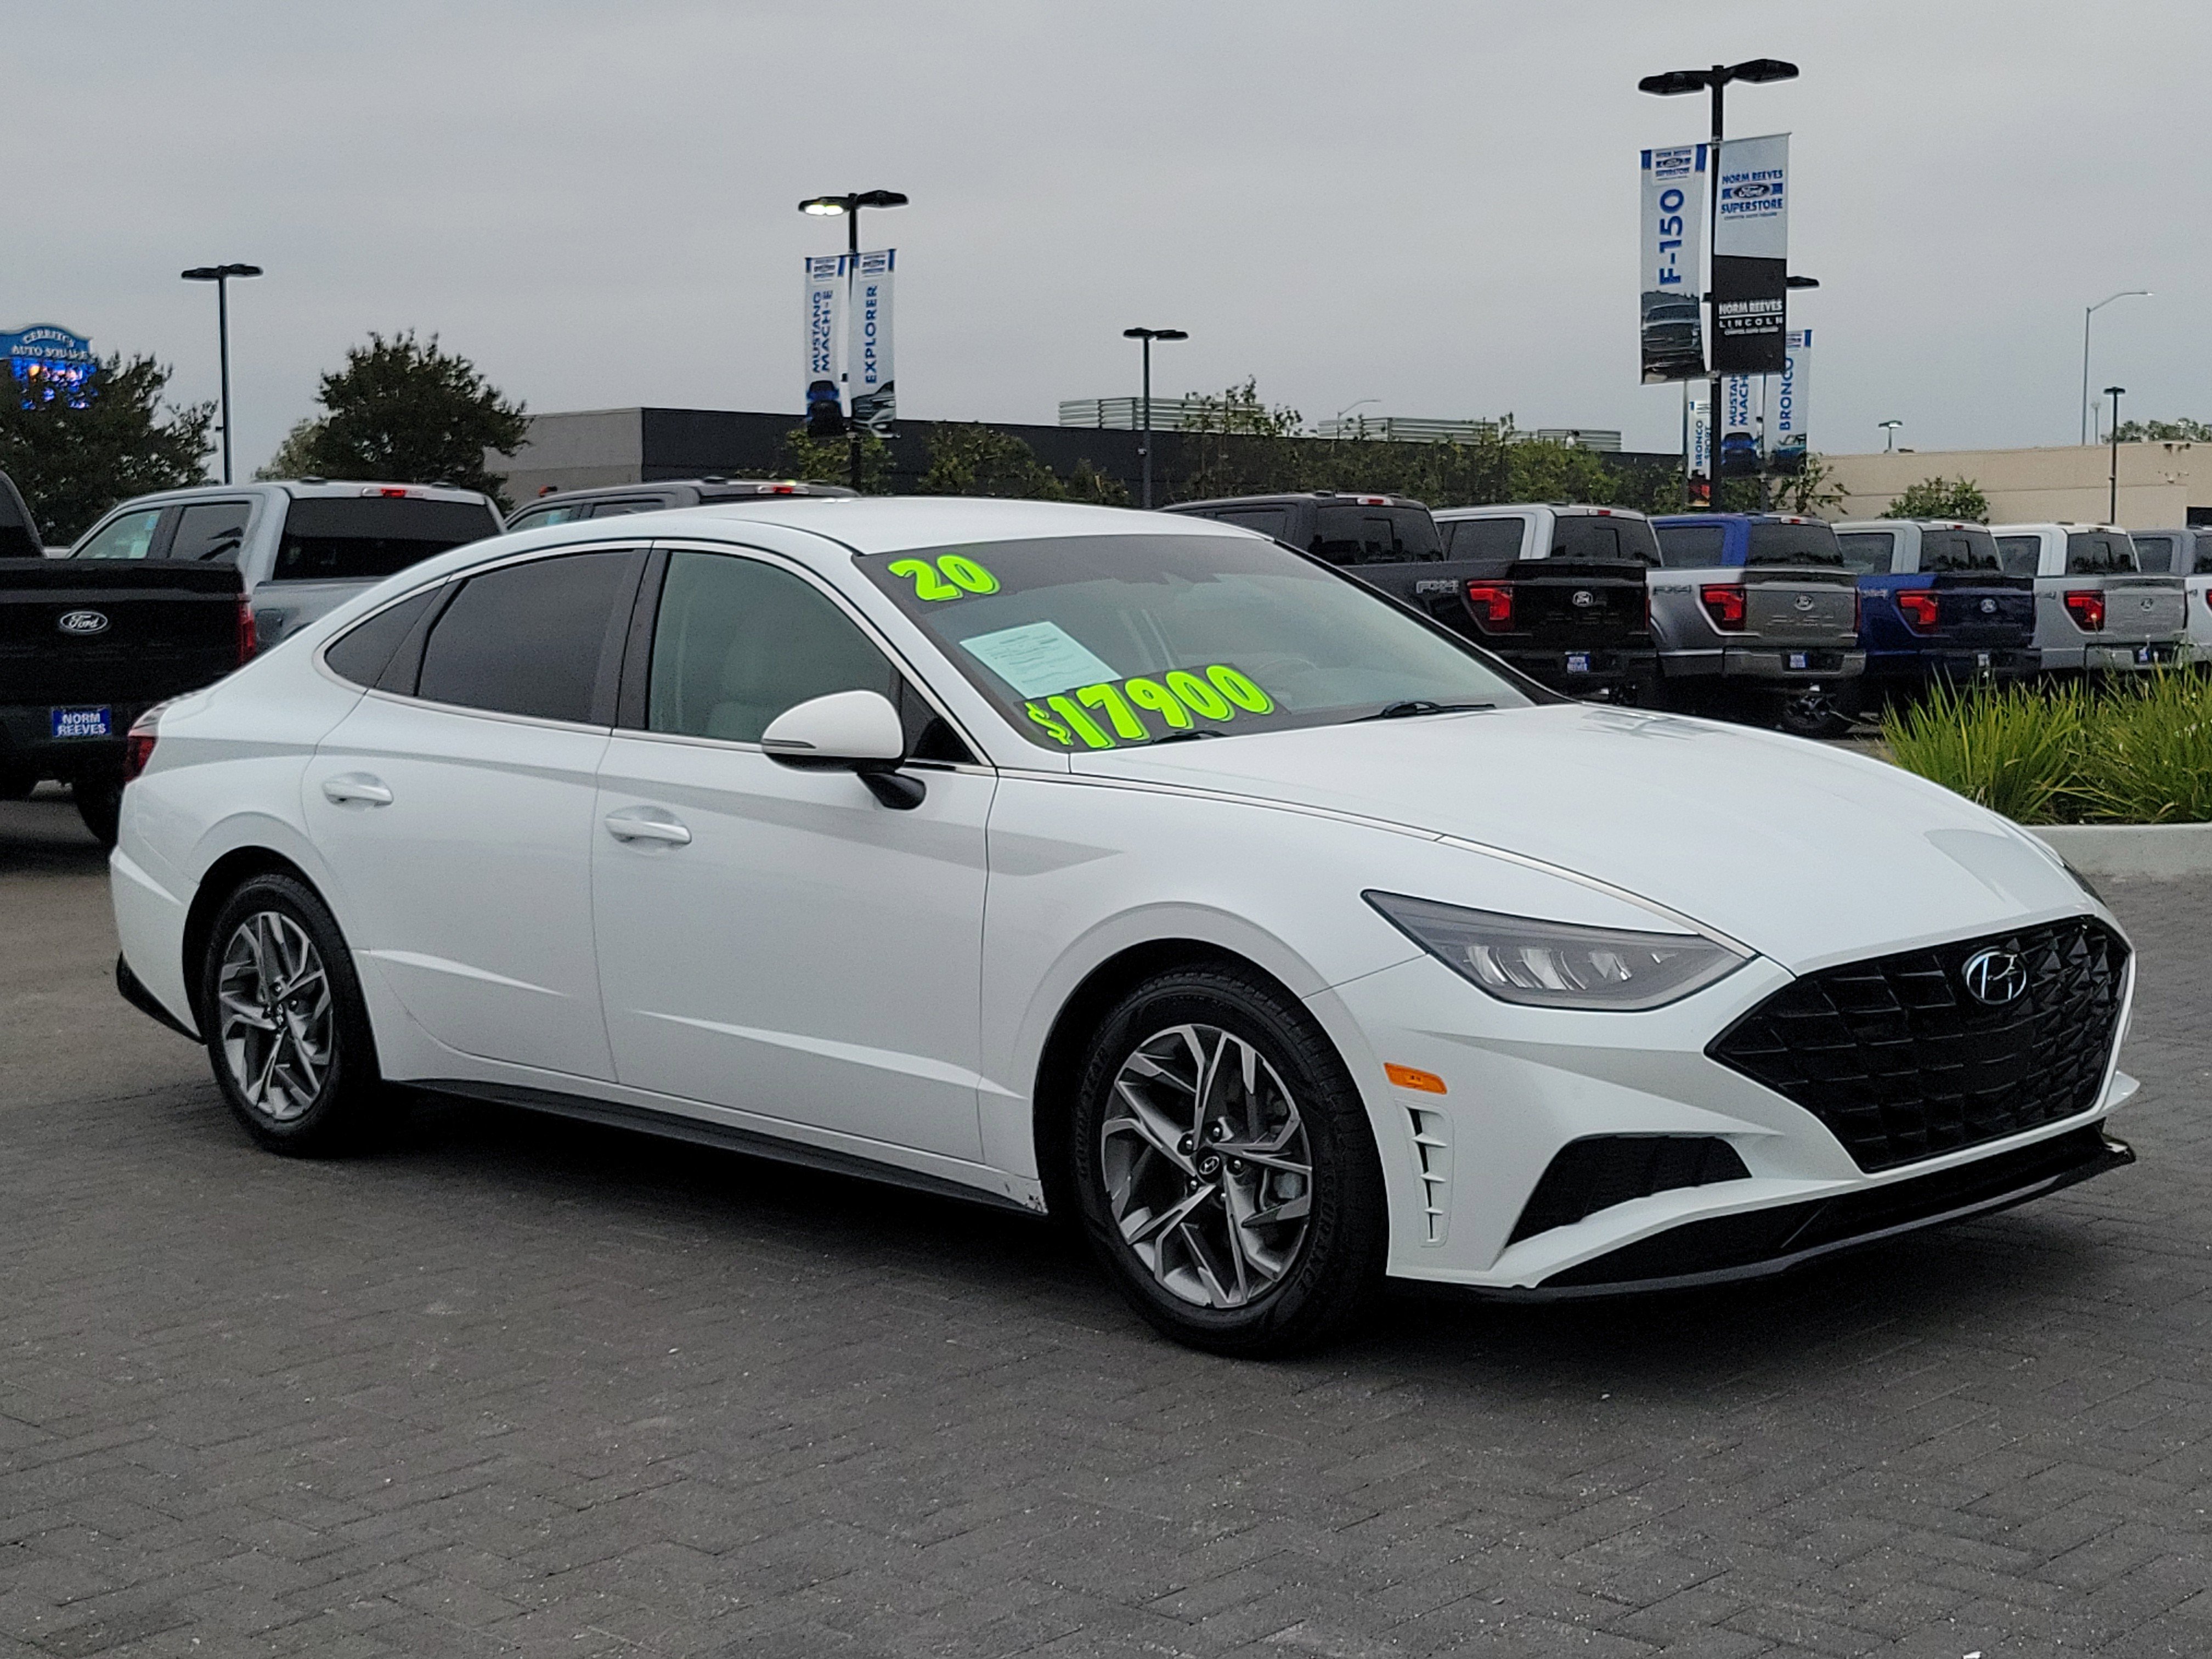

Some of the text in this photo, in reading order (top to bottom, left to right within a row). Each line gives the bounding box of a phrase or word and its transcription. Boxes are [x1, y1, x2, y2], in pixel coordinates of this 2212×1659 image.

[1722, 170, 1783, 184] NORM REEVES
[1721, 198, 1782, 214] SUPERSTORE
[1659, 189, 1684, 285] F-150
[1719, 300, 1782, 314] NORM REEVES
[1719, 316, 1783, 328] LINCOLN
[11, 345, 43, 357] AUTO
[812, 291, 821, 373] MUSTANG
[822, 290, 833, 373] MACH-E
[865, 285, 877, 383] EXPLORER
[1729, 374, 1737, 426] MUSTAN
[1739, 375, 1748, 426] MACH
[1779, 358, 1793, 431] BRONCO
[889, 554, 1001, 602] 20
[69, 614, 99, 629] Ford
[58, 724, 106, 736] REEVES
[63, 713, 100, 724] NORM
[1025, 664, 1276, 750] $17900
